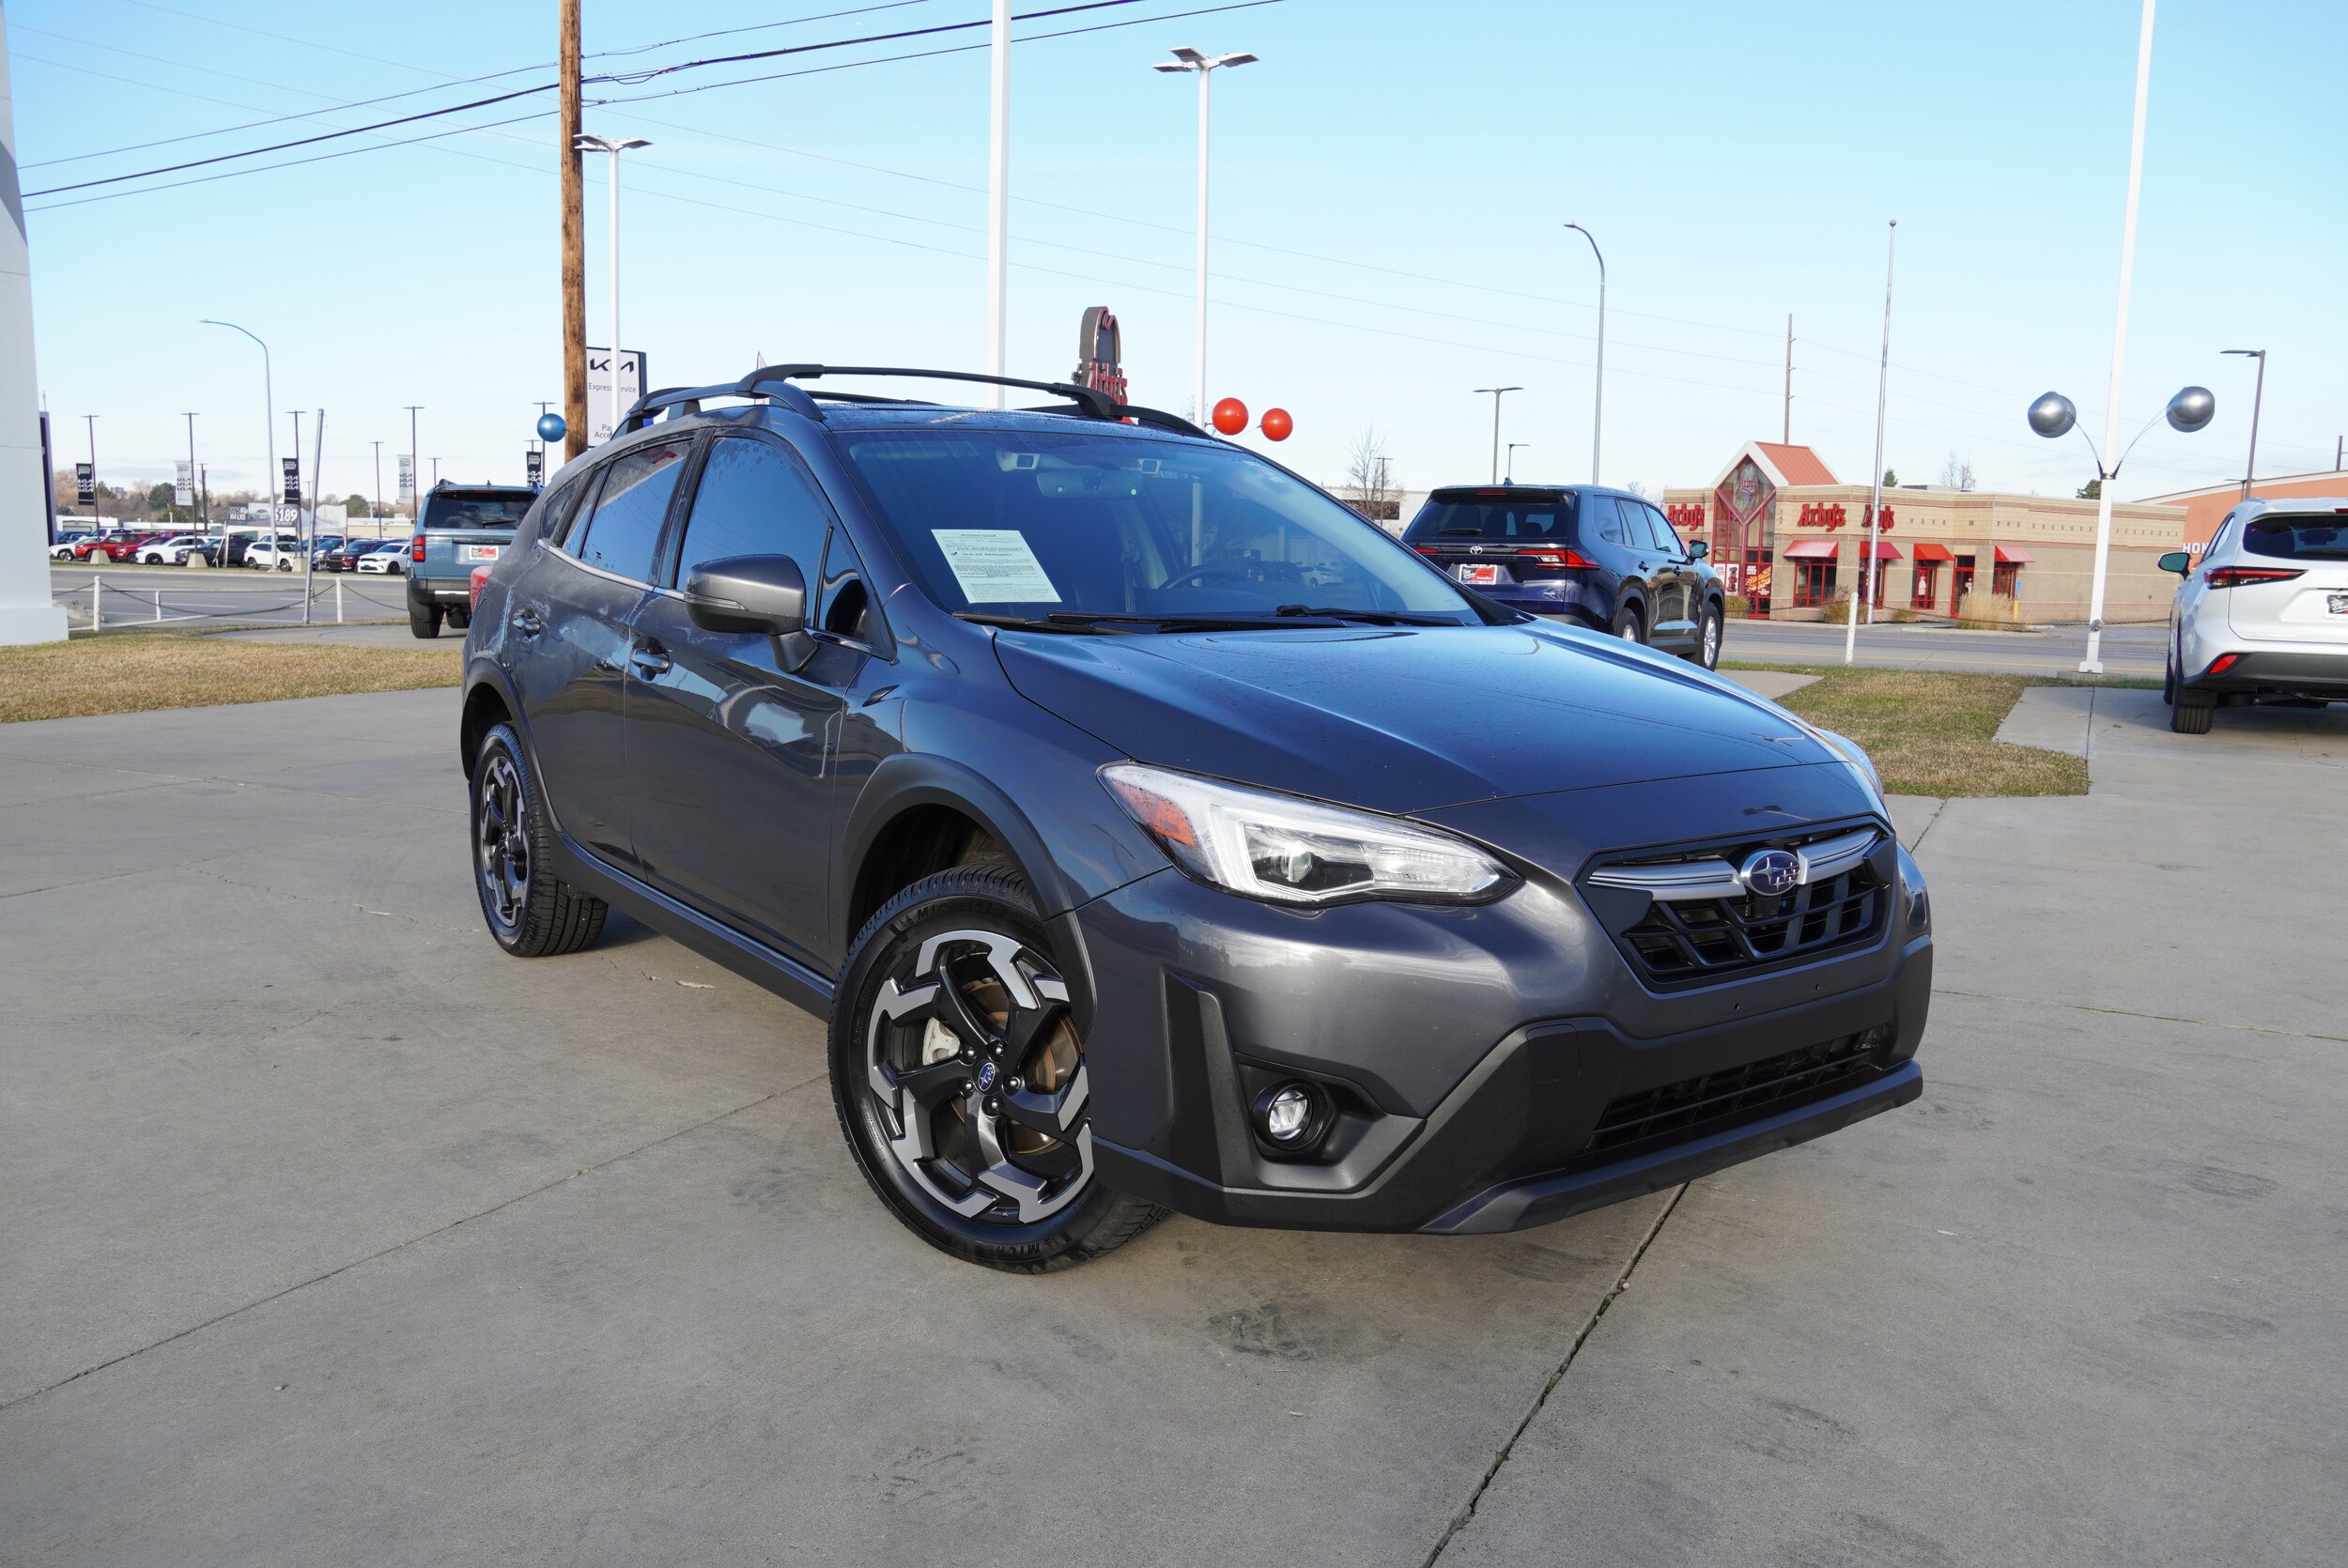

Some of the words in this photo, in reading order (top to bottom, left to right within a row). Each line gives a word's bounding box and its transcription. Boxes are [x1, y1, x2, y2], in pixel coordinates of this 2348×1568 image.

[590, 358, 634, 373] KA
[1667, 503, 1705, 531] Arby's
[1798, 502, 1846, 532] Arby's
[1861, 503, 1895, 534] Ay's
